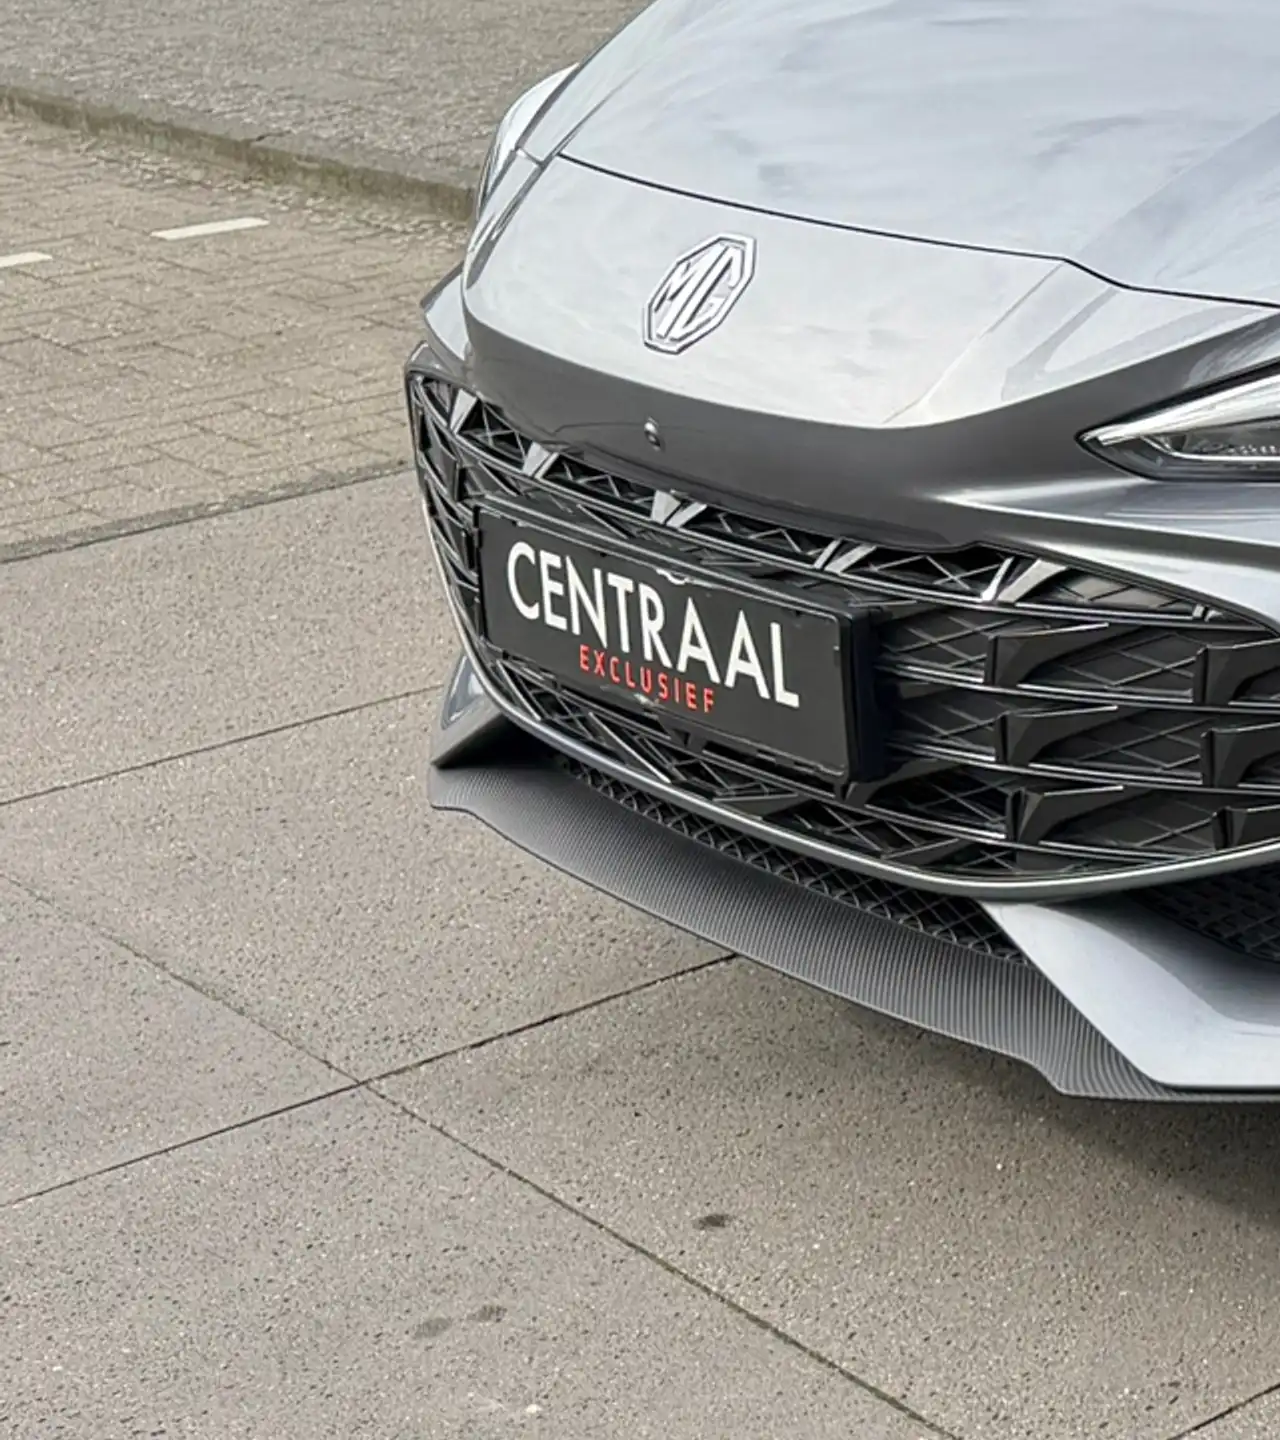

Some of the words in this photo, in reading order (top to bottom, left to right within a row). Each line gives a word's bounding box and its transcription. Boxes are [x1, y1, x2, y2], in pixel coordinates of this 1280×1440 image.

[649, 237, 751, 348] MG
[507, 541, 800, 708] CENTRAAL
[580, 643, 715, 713] EXCLUSIEF
